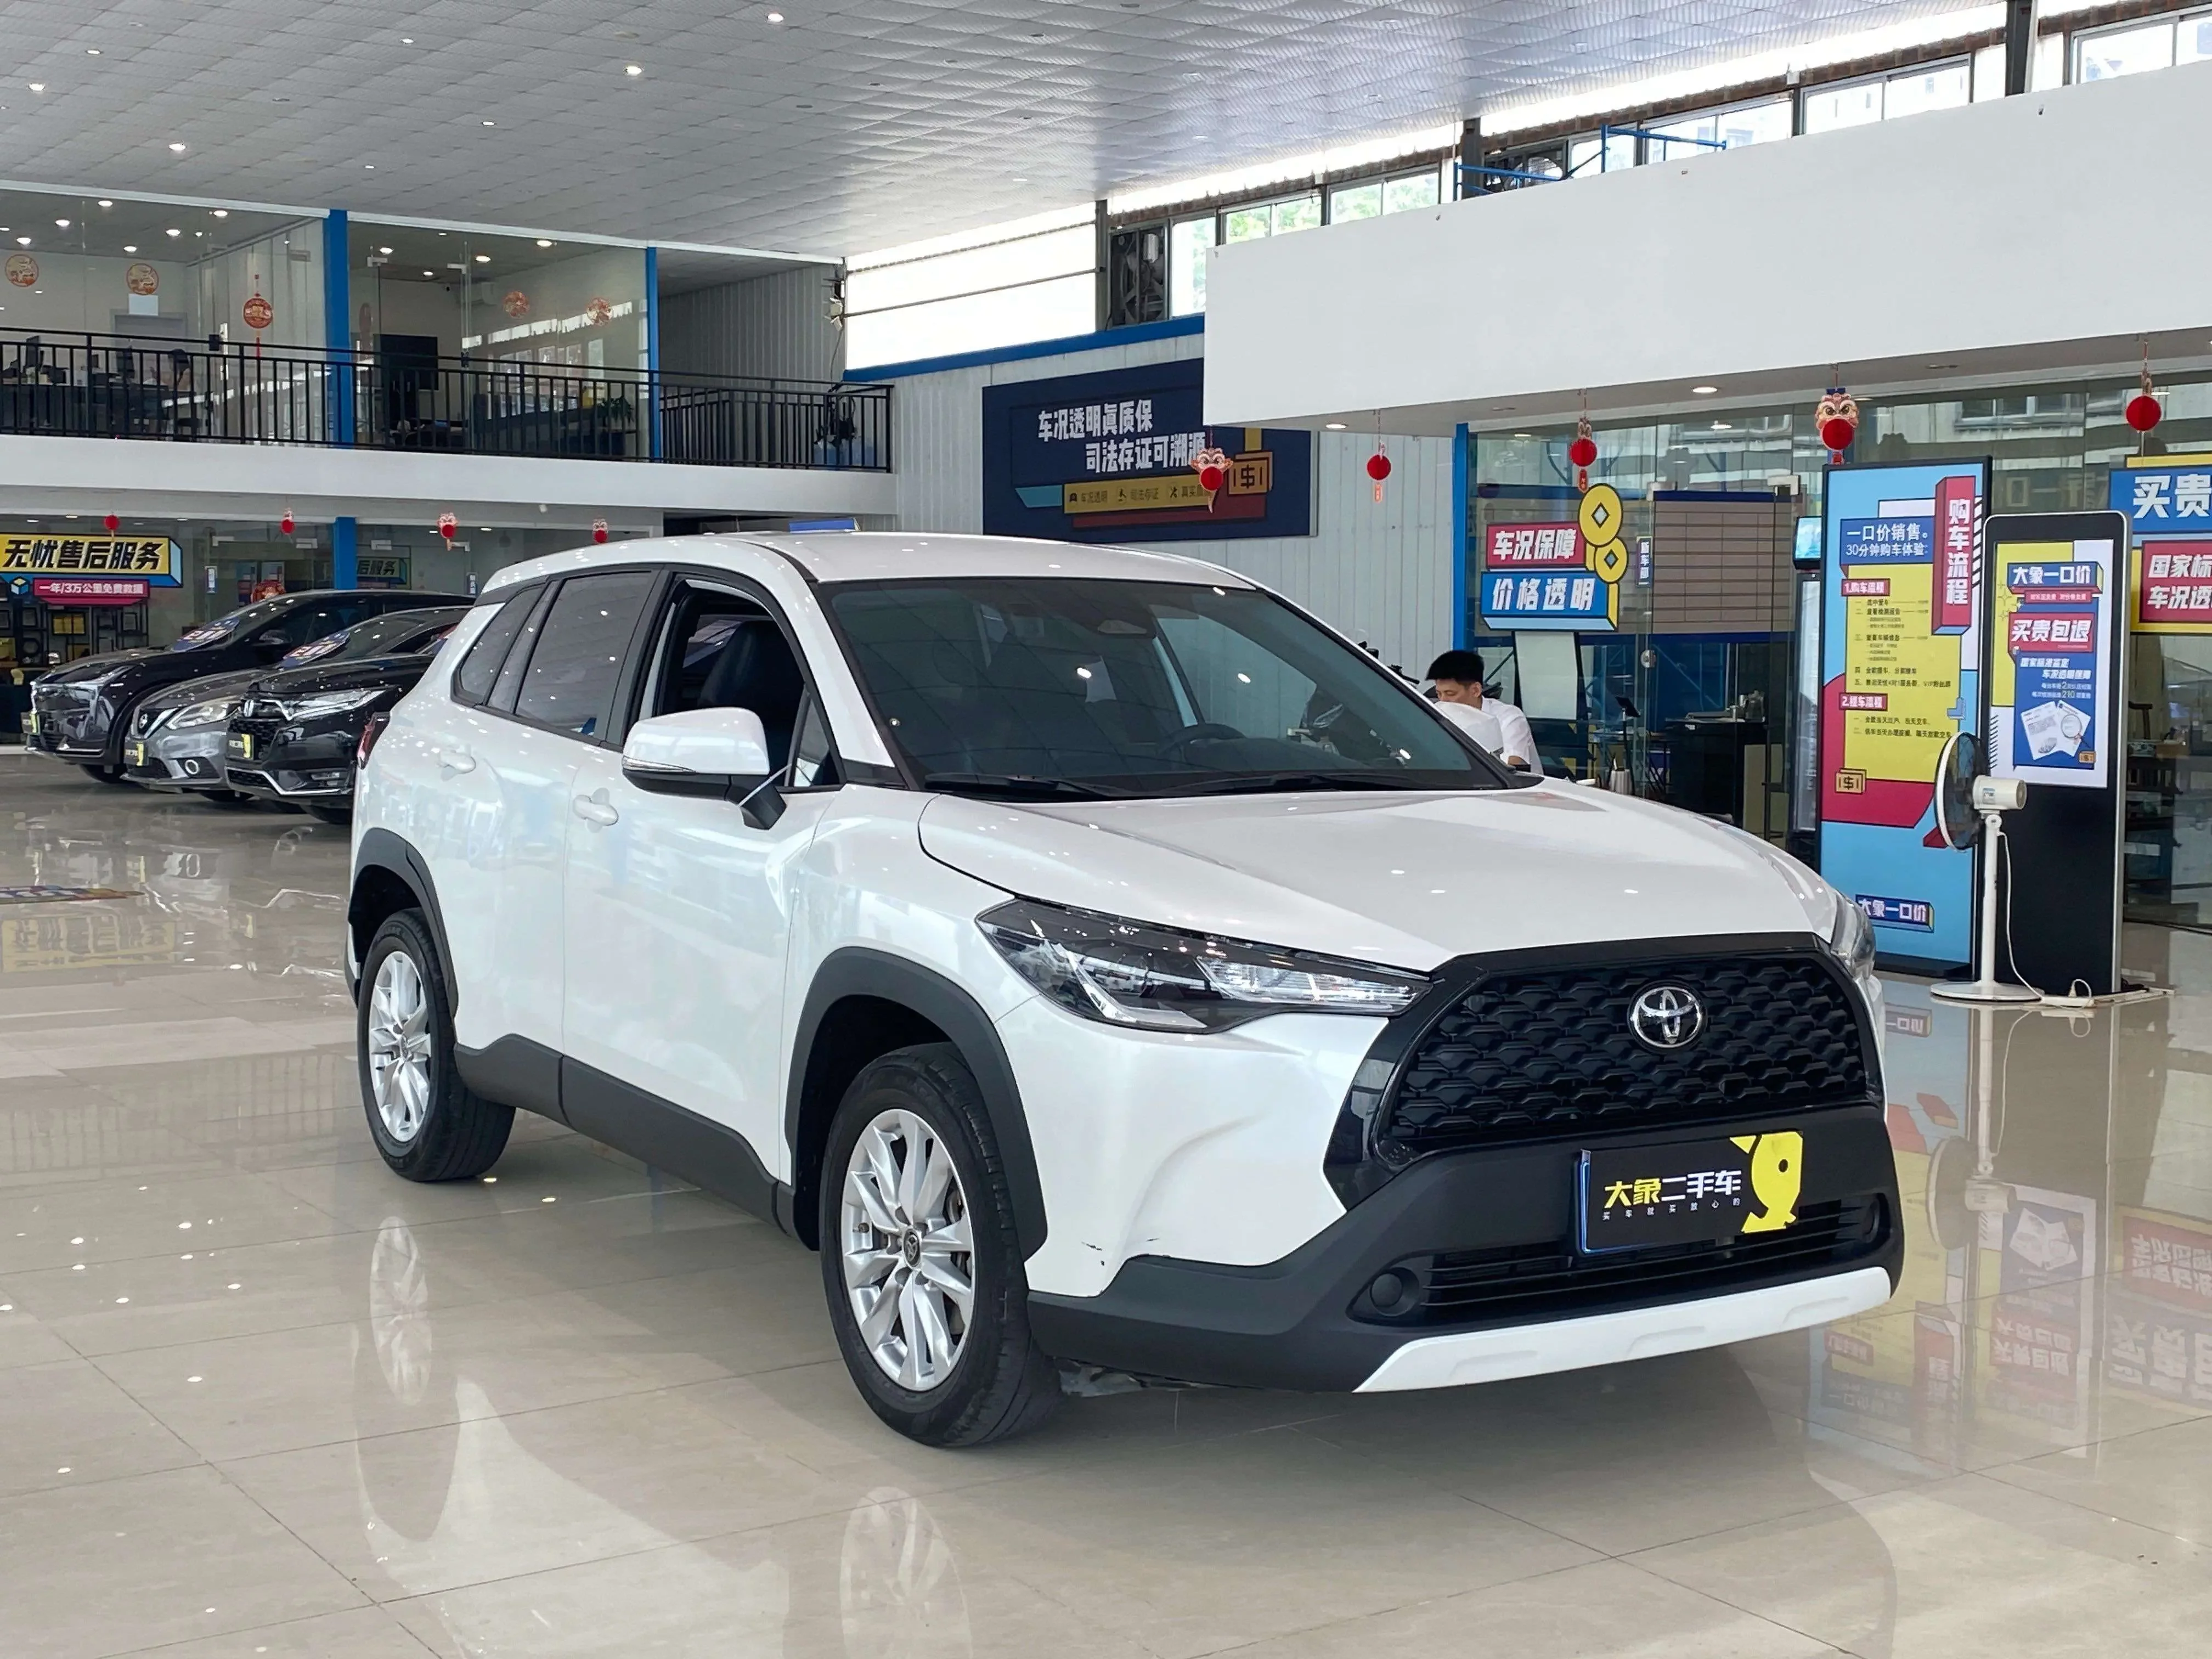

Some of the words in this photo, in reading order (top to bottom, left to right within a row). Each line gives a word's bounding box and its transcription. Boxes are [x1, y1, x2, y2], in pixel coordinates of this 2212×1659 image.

[1085, 431, 1206, 474] 司法存证可溯源
[2133, 473, 2212, 518] 买贵
[1493, 528, 1577, 560] 车况保障
[1847, 522, 1928, 541] 一口价销售。
[3, 539, 163, 570] 无忧售后服务
[1946, 498, 1971, 605] 购车流程
[2013, 565, 2091, 585] 大象一口价
[2148, 554, 2212, 578] 国家标
[1492, 577, 1596, 611] 价格透明
[2147, 585, 2212, 610] 车况透
[2011, 619, 2091, 642] 买贵包退
[1858, 898, 1927, 922] 大象一口价
[1604, 1170, 1742, 1209] 大象二手车
[1602, 1197, 1741, 1221] 买车就买放心的
